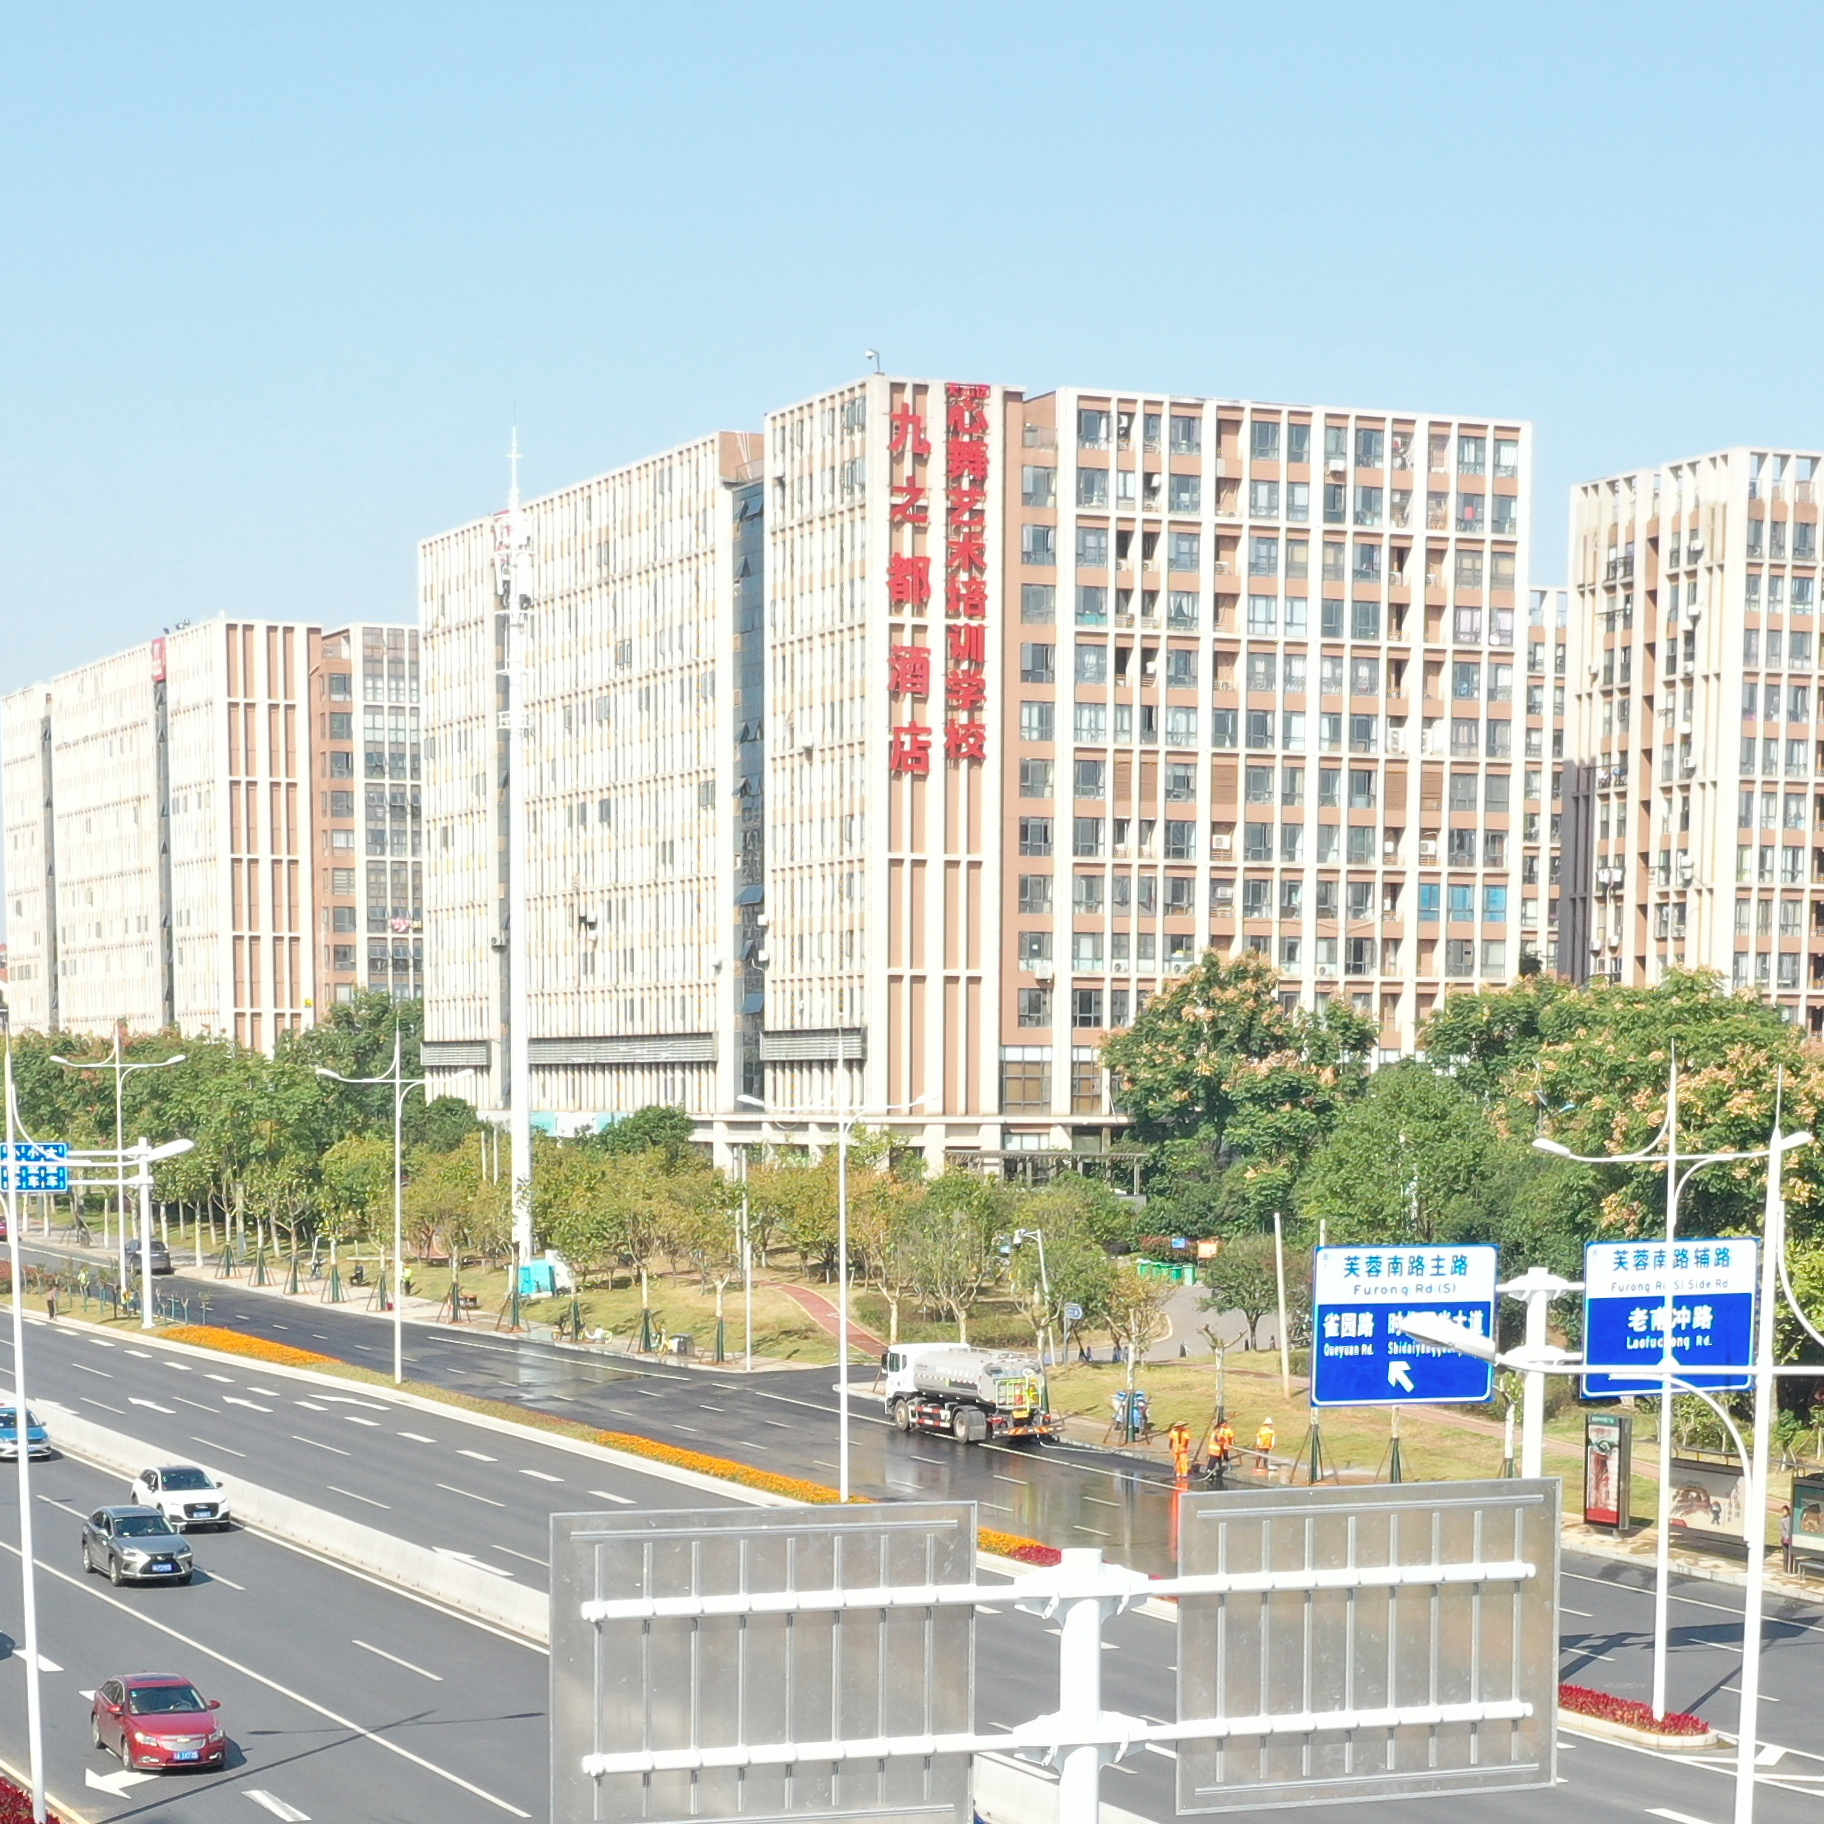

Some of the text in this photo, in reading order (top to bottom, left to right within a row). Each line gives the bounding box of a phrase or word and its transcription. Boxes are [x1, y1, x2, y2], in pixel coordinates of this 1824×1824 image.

[887, 403, 931, 776] 九之都酒店
[1344, 1254, 1468, 1278] 芙蓉南路主路
[1613, 1248, 1730, 1271] 芙蓉南路辅路
[1353, 1284, 1409, 1296] Furong
[1611, 1281, 1650, 1292] Furong
[1688, 1279, 1711, 1290] Side
[1716, 1278, 1728, 1288] Rd
[1627, 1336, 1690, 1350] Laofucong
